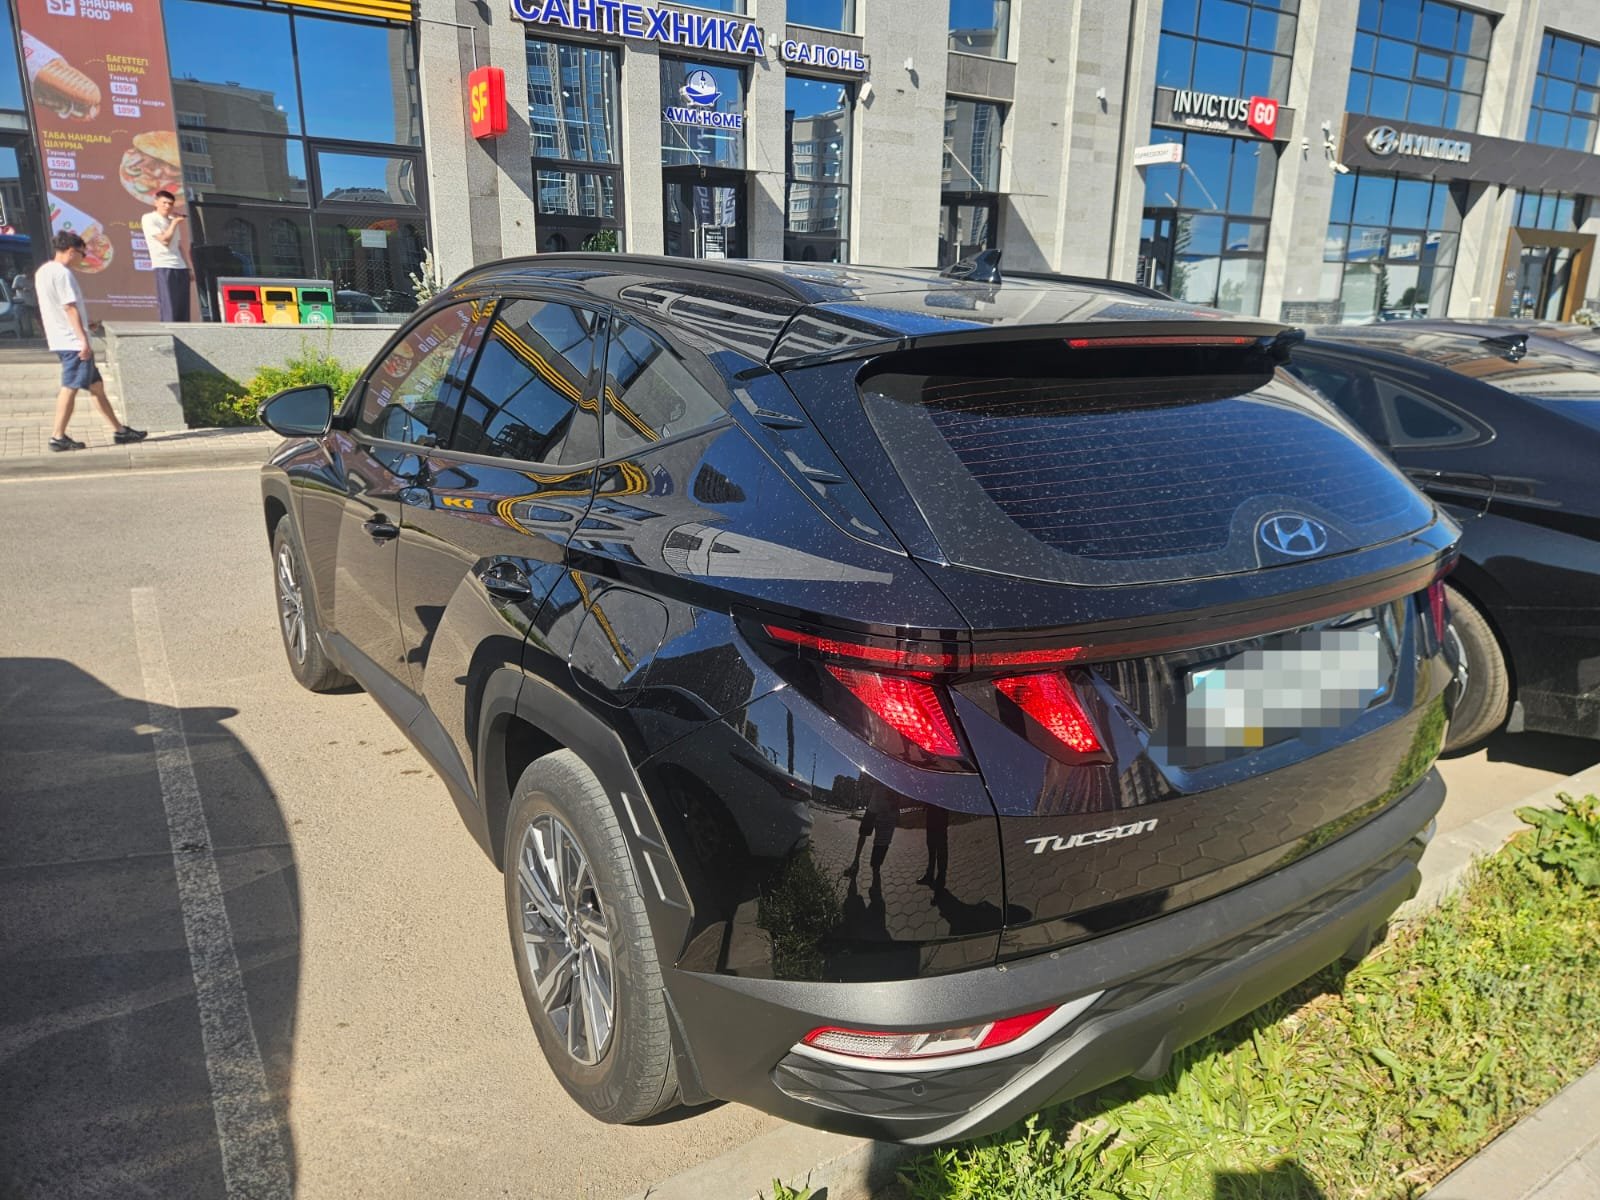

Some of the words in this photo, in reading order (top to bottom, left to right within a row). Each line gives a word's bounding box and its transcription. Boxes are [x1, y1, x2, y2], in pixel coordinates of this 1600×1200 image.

[81, 7, 111, 20] FOOD
[511, 0, 765, 56] САНТЕХНИКА
[472, 81, 488, 124] SF
[1173, 89, 1249, 122] INVICTUS
[1254, 102, 1275, 125] GO
[702, 110, 742, 128] HOME
[42, 130, 66, 140] ТАБА
[44, 139, 84, 150] ШАУРМА
[1398, 132, 1471, 163] HYUNDAI
[1025, 818, 1159, 854] Tucson
